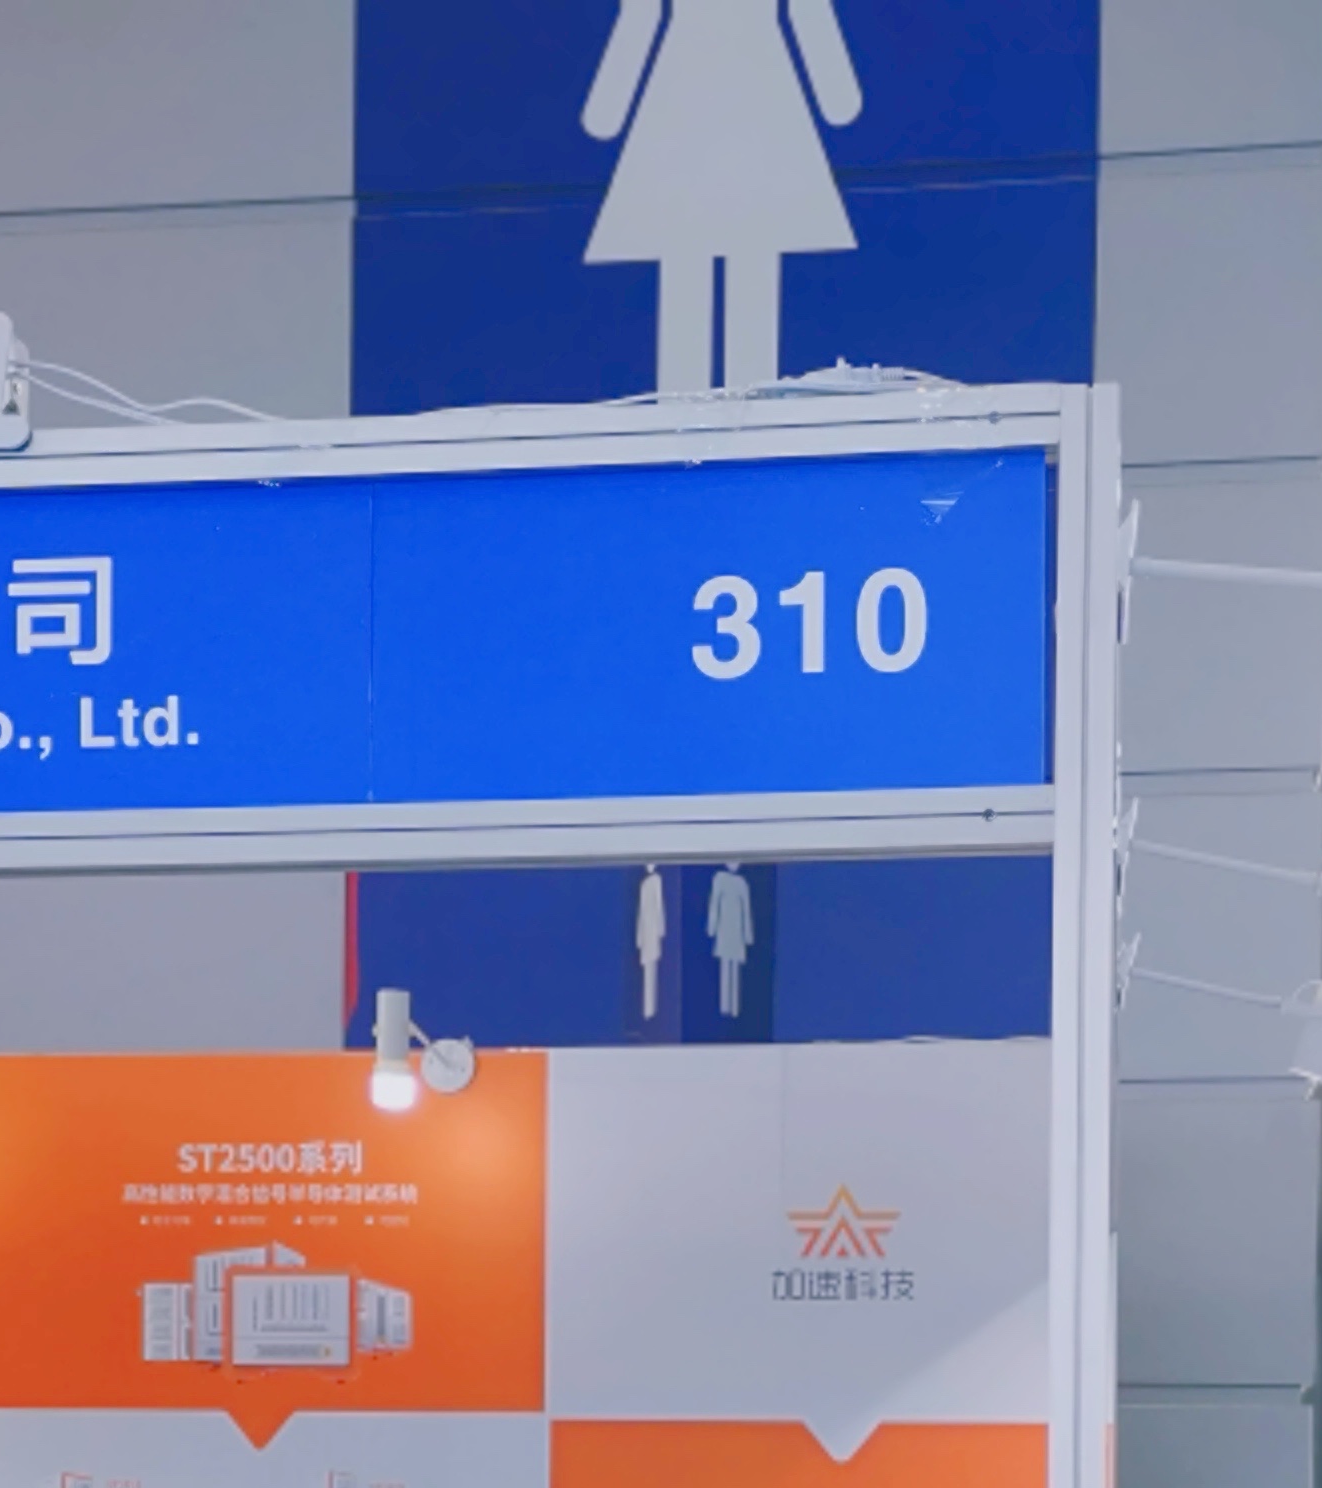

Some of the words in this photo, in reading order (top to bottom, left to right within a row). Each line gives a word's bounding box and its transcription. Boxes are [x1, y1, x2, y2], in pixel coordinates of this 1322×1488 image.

[691, 567, 927, 680] 310
[79, 696, 200, 748] Ltd.
[178, 1139, 364, 1175] ST2500系列
[772, 1268, 915, 1302] 加速科技
